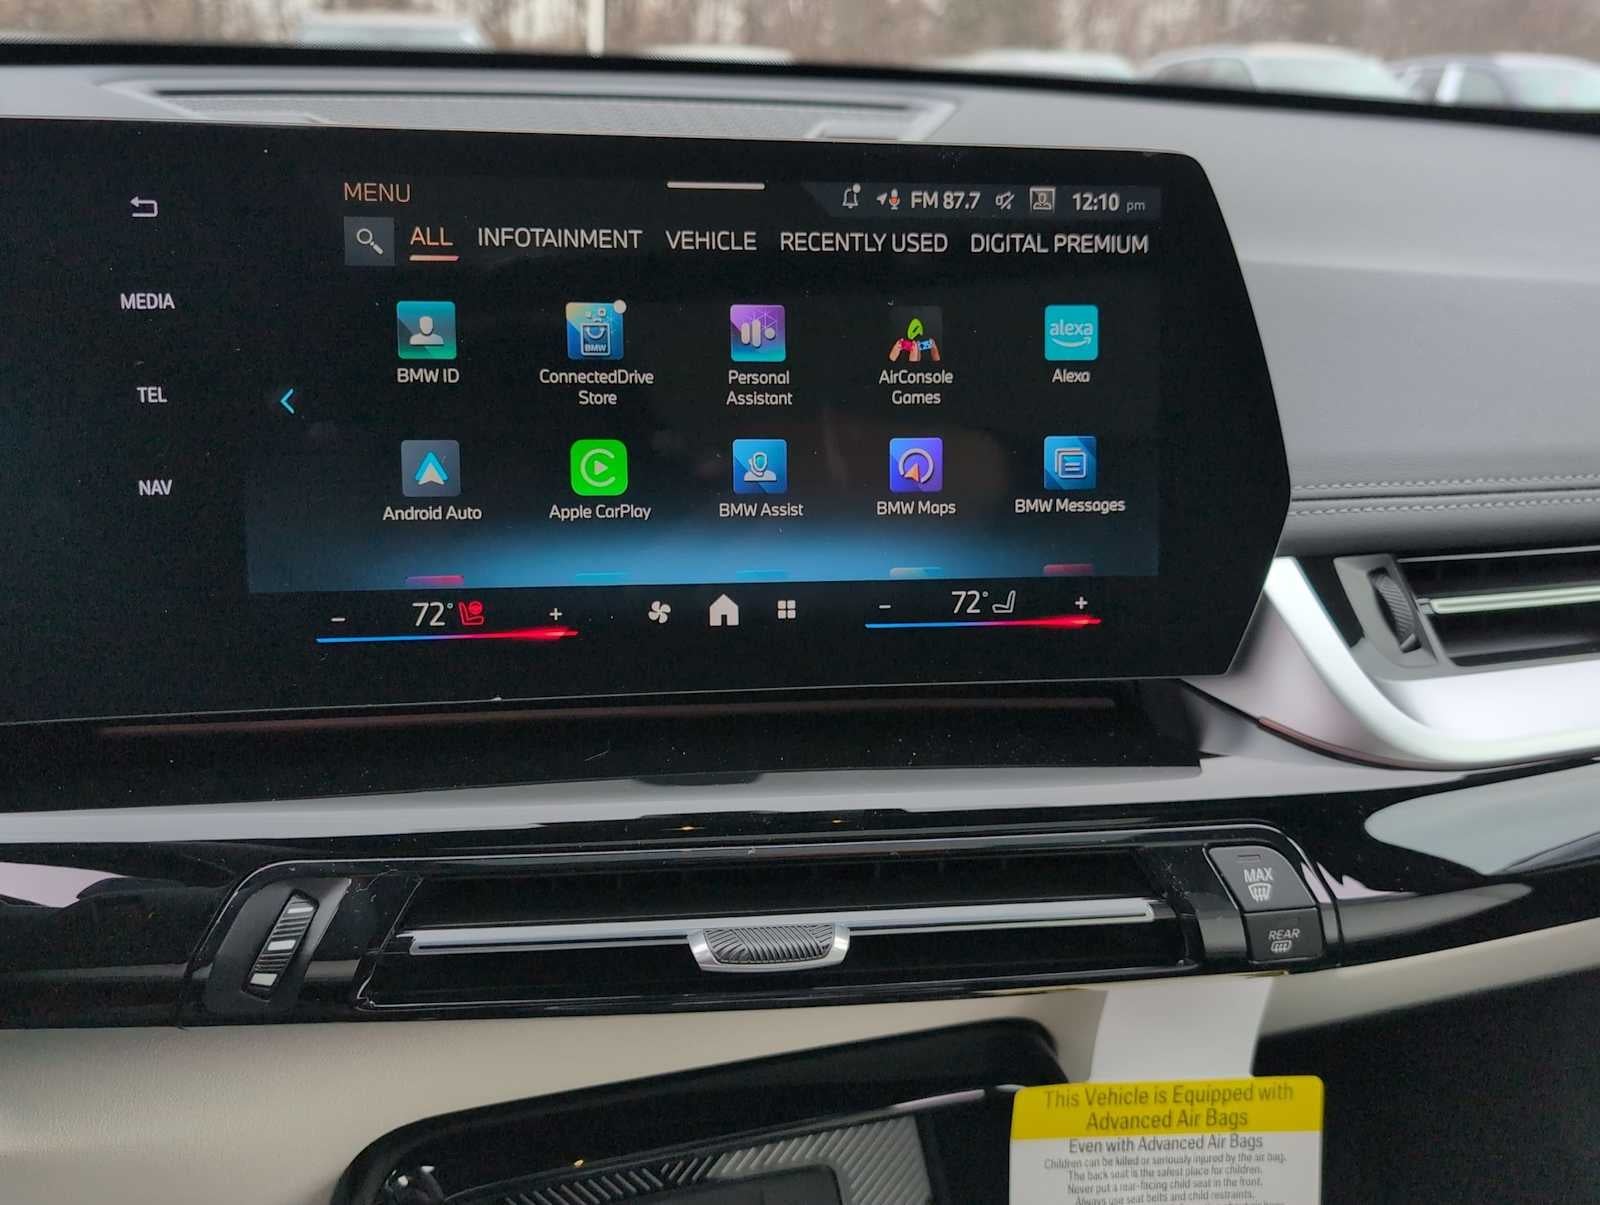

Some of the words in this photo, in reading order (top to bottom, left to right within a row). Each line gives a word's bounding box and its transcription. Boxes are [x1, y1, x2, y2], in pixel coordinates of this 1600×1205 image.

[344, 182, 411, 203] MENU
[911, 192, 938, 209] FM
[943, 192, 980, 210] 87.7
[1072, 193, 1120, 211] 12:10
[1126, 200, 1145, 213] pm
[410, 227, 453, 246] ALL
[478, 227, 643, 249] INFOTAINMENT
[665, 231, 757, 251] VEHICLE
[780, 232, 886, 253] RECENTLY
[892, 233, 948, 253] USED
[970, 233, 1048, 254] DIGITAL
[1054, 234, 1149, 254] PREMIUM
[120, 293, 175, 310] MEDIA
[1050, 320, 1093, 336] alexa
[585, 343, 607, 352] BMW
[397, 368, 440, 384] BMW
[443, 368, 459, 384] ID
[539, 368, 654, 385] ConnectedDrive
[728, 370, 790, 386] Personal
[879, 369, 954, 385] AirConsole
[1052, 368, 1090, 383] Alexa
[137, 387, 167, 403] TEL
[578, 390, 617, 405] Store
[726, 390, 792, 406] Assistant
[891, 390, 941, 405] Games
[139, 480, 172, 496] NAV
[382, 505, 442, 521] Android
[445, 505, 482, 520] Auto
[549, 504, 592, 522] Apple
[595, 504, 651, 521] CarPlay
[719, 503, 757, 517] BMW
[760, 502, 804, 516] Assist
[876, 501, 914, 515] BMW
[917, 501, 956, 517] Maps
[1015, 499, 1053, 514] BMW
[1055, 498, 1126, 515] Messages
[1244, 867, 1273, 883] MAX
[1268, 928, 1300, 940] REAR
[1045, 1090, 1080, 1108] This
[1085, 1087, 1150, 1106] Vehicle
[1154, 1087, 1167, 1104] is
[1172, 1083, 1254, 1106] Equipped
[1258, 1083, 1293, 1101] with
[1086, 1109, 1172, 1131] Advanced
[1176, 1109, 1201, 1128] Air
[1206, 1108, 1248, 1130] Bags
[1069, 1138, 1103, 1153] Even
[1105, 1137, 1134, 1152] with
[1137, 1134, 1204, 1151] Advanced
[1207, 1134, 1226, 1149] Air
[1230, 1133, 1263, 1151] Bags
[1044, 1158, 1082, 1169] Children
[1102, 1157, 1113, 1166] be
[1115, 1156, 1139, 1166] killed
[1225, 1152, 1236, 1163] by
[1238, 1152, 1252, 1162] the
[1069, 1169, 1085, 1180] The
[1087, 1168, 1108, 1180] back
[1140, 1167, 1154, 1177] the
[1185, 1166, 1208, 1177] place
[1211, 1165, 1222, 1175] for
[1068, 1184, 1093, 1194] Never
[1095, 1183, 1110, 1194] put
[1170, 1178, 1190, 1189] child
[1223, 1177, 1237, 1187] the
[1170, 1190, 1186, 1201] and
[1188, 1190, 1209, 1201] child
